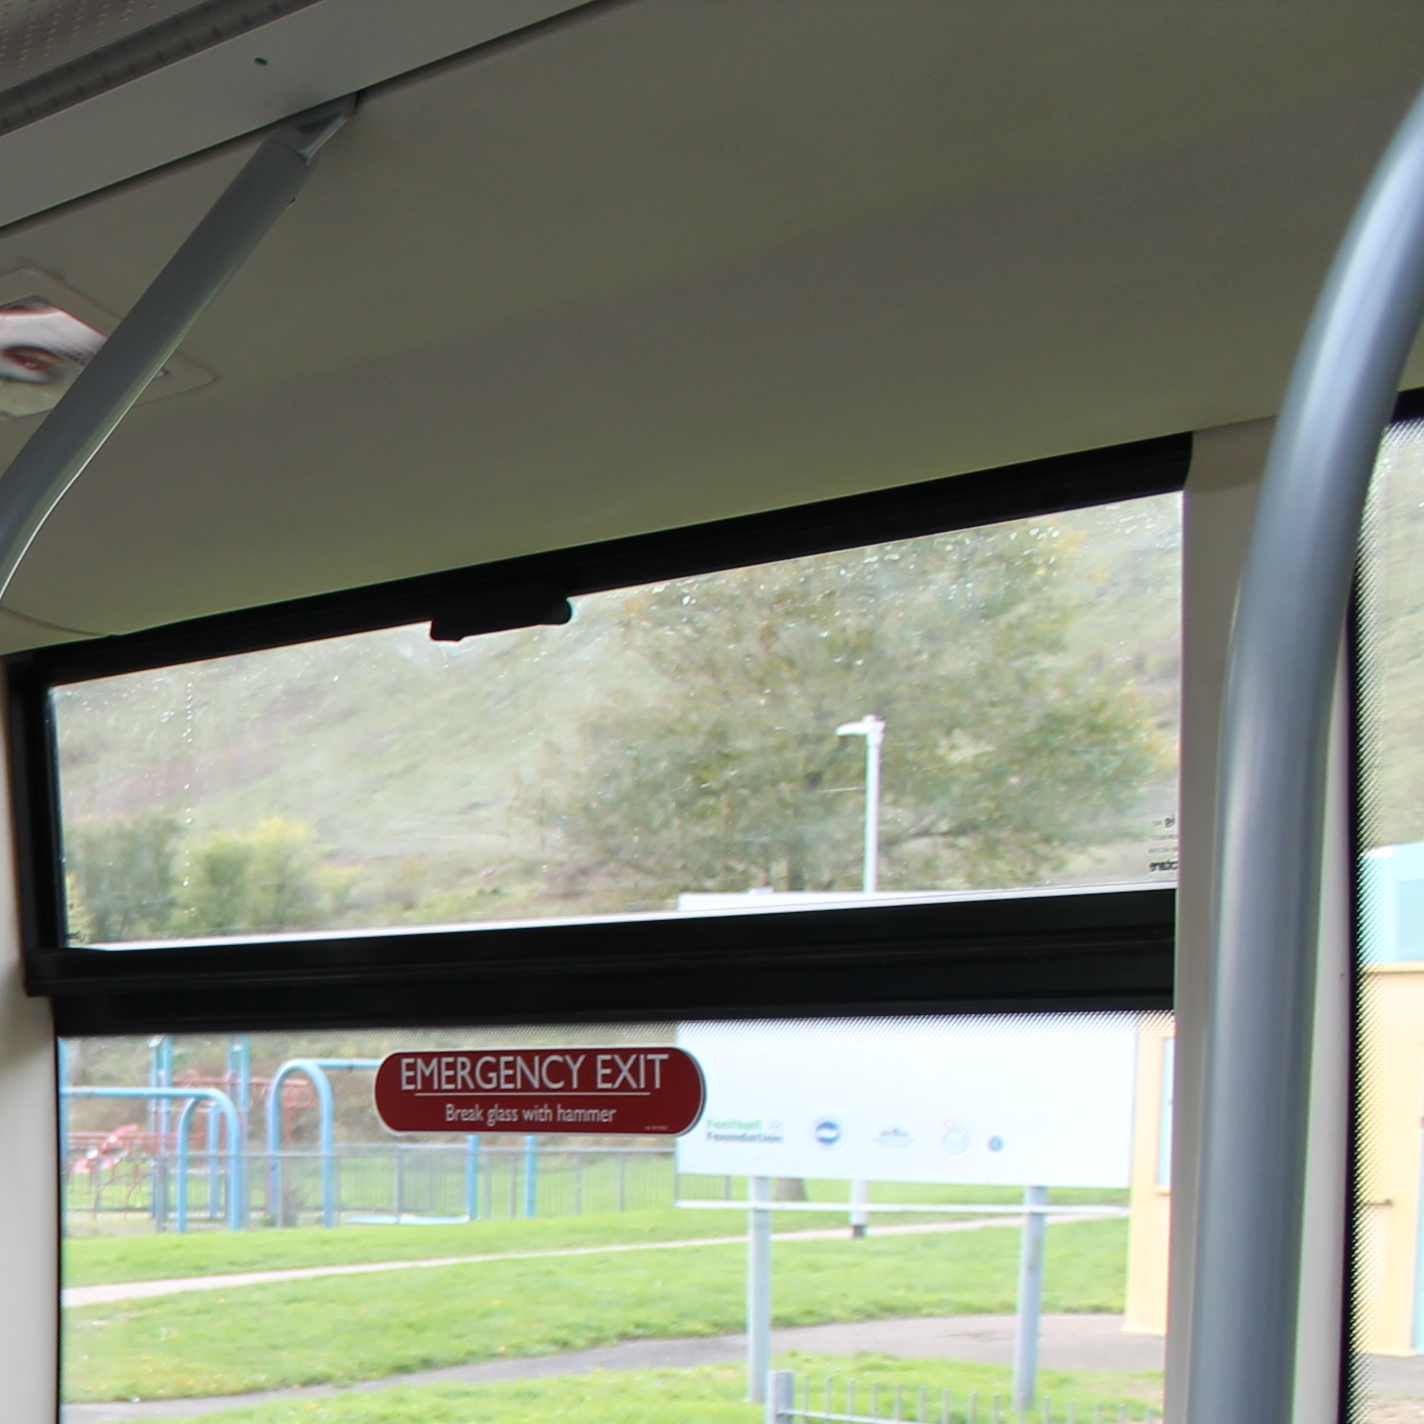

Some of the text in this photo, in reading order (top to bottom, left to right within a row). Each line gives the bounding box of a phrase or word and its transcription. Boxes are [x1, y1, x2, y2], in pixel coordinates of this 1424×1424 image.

[401, 1053, 670, 1091] EMERGENCY EXIT
[445, 1103, 617, 1127] Break glass with hammer
